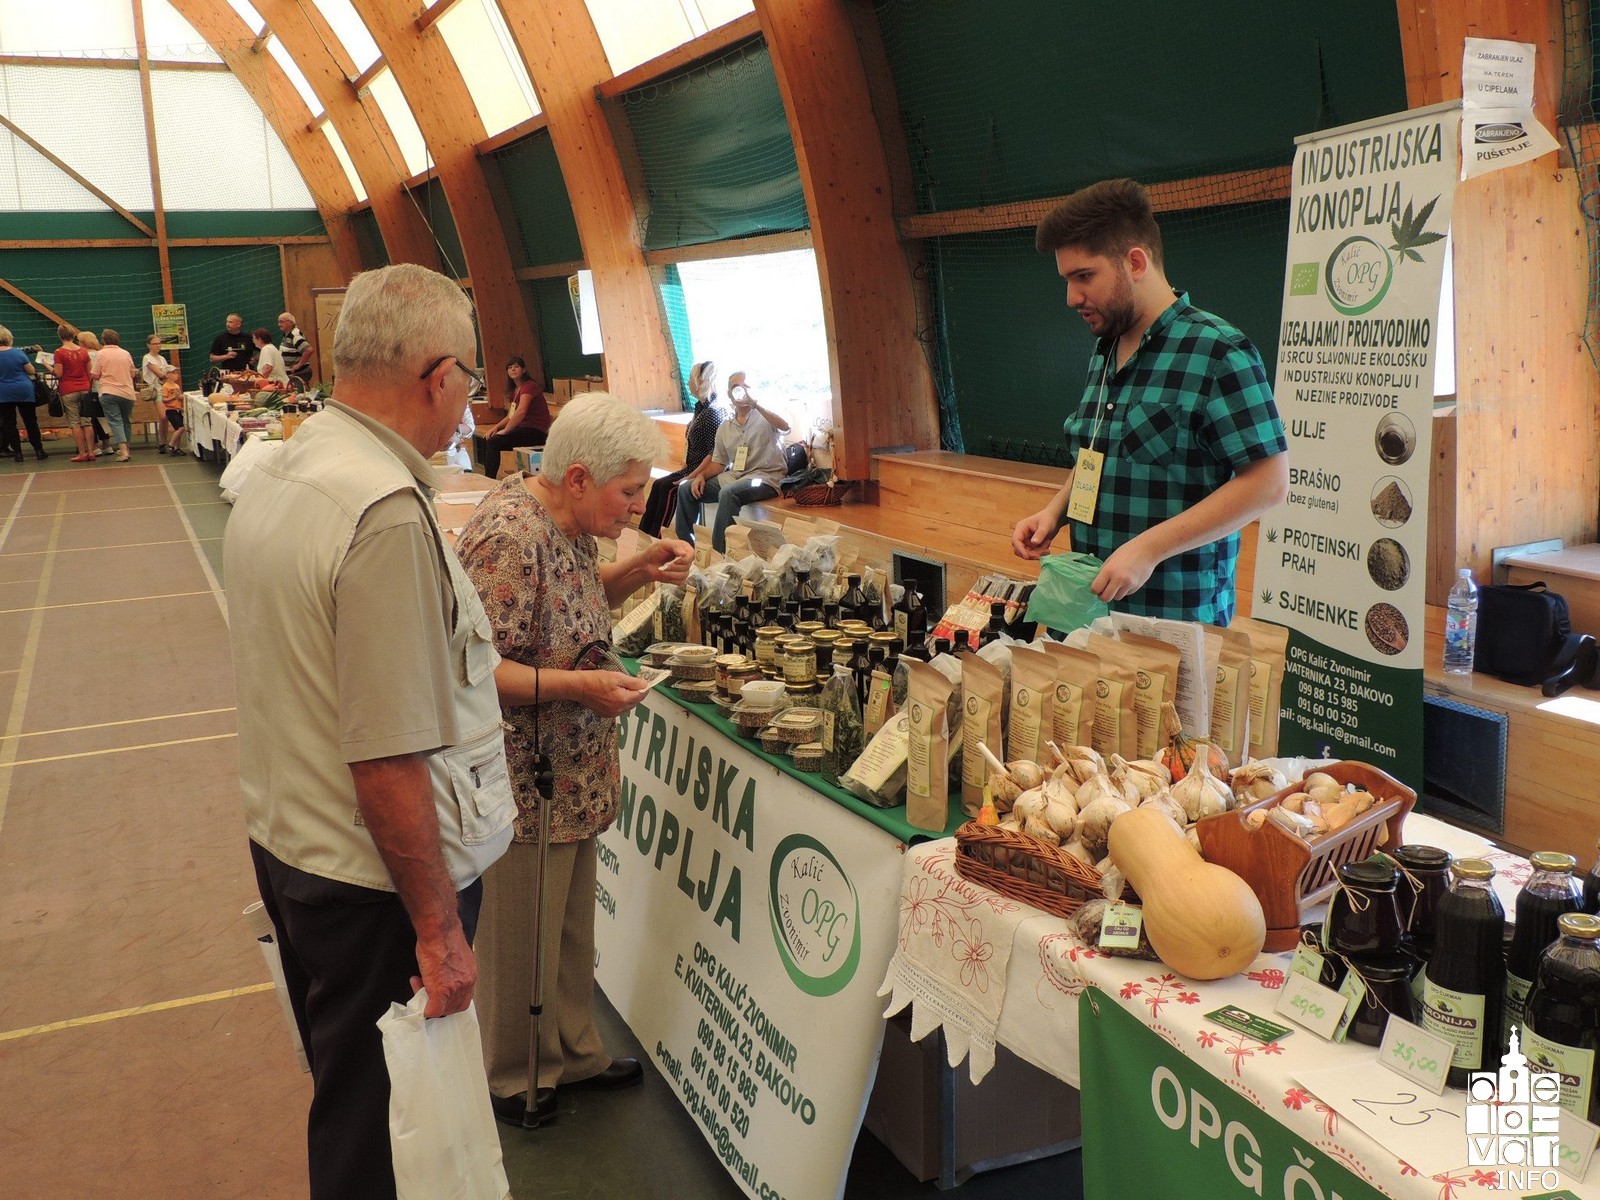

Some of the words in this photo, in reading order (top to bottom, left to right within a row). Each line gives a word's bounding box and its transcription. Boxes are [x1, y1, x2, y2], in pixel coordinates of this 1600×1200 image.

[1477, 52, 1509, 62] ZABRANJEN
[1509, 56, 1524, 64] ULAZ
[1478, 84, 1483, 92] U
[1485, 84, 1518, 95] CIPELAMA
[1477, 129, 1520, 138] ZABRANJENO
[1301, 123, 1442, 186] INDUSTRIJSKA
[1477, 140, 1532, 161] PUŠENJE
[1296, 181, 1401, 234] KONOPLJA
[1347, 260, 1381, 292] OPG
[1282, 320, 1339, 348] UZGAJAMO
[1340, 320, 1344, 347] I
[1346, 318, 1430, 348] PROIZVODIMO
[1281, 351, 1285, 363] U
[1287, 350, 1313, 364] SRCU
[1316, 351, 1367, 365] SLAVONIJE
[1369, 350, 1427, 367] EKOLOŠKU
[1284, 370, 1351, 385] INDUSTRIJSKU
[1356, 372, 1412, 388] KONOPLJU
[1415, 375, 1419, 389] I
[1295, 389, 1337, 404] NJEZINE
[1339, 391, 1398, 409] PROIZVODE
[1292, 419, 1326, 440] ULJE
[1289, 468, 1341, 492] BRAŠNO
[1286, 491, 1306, 505] (bez
[1307, 494, 1339, 514] glutena)
[1283, 528, 1360, 561] PROTEINSKI
[1282, 551, 1316, 575] PRAH
[1279, 590, 1358, 630] SJEMENKE
[1290, 646, 1307, 662] OPG
[1308, 651, 1328, 670] Kalić
[1329, 659, 1371, 683] Zvonimir
[1284, 661, 1332, 687] VATERNIKA
[1333, 677, 1348, 694] 23,
[1349, 682, 1394, 706] ĐAKOVO
[1298, 681, 1312, 696] 099
[1313, 687, 1325, 701] 88
[1327, 691, 1339, 705] 15
[1341, 696, 1358, 712] 985
[1297, 696, 1311, 712] 091
[1312, 703, 1324, 717] 60
[1326, 708, 1338, 721] 00
[1340, 712, 1358, 728] 520
[1280, 707, 1295, 721] ail:
[1297, 714, 1396, 758] opg.kalic@gmail.com
[791, 856, 824, 882] Kalić
[780, 894, 810, 961] Zvonimir
[801, 888, 848, 962] OPG
[693, 941, 717, 977] OPG
[715, 963, 748, 1011] KALIĆ
[743, 996, 798, 1073] ZVONIMIR
[1440, 990, 1461, 1001] ČUKMAN
[674, 953, 683, 980] E.
[684, 965, 740, 1048] KVATERNIKA
[739, 1032, 753, 1070] 23,
[755, 1051, 816, 1125] ĐAKOVO
[1540, 1043, 1564, 1055] ČUKMAN
[697, 1018, 714, 1051] 099
[713, 1038, 726, 1067] 88
[726, 1055, 740, 1084] 15
[737, 1070, 758, 1108] 985
[691, 1046, 707, 1080] 091
[707, 1068, 719, 1096] 60
[718, 1084, 731, 1114] 00
[730, 1101, 750, 1140] 520
[1351, 1093, 1460, 1125] 25
[683, 1077, 786, 1200] opg.kalic@gmail.c
[1152, 1065, 1262, 1197] OPG
[1284, 1147, 1340, 1200] Č
